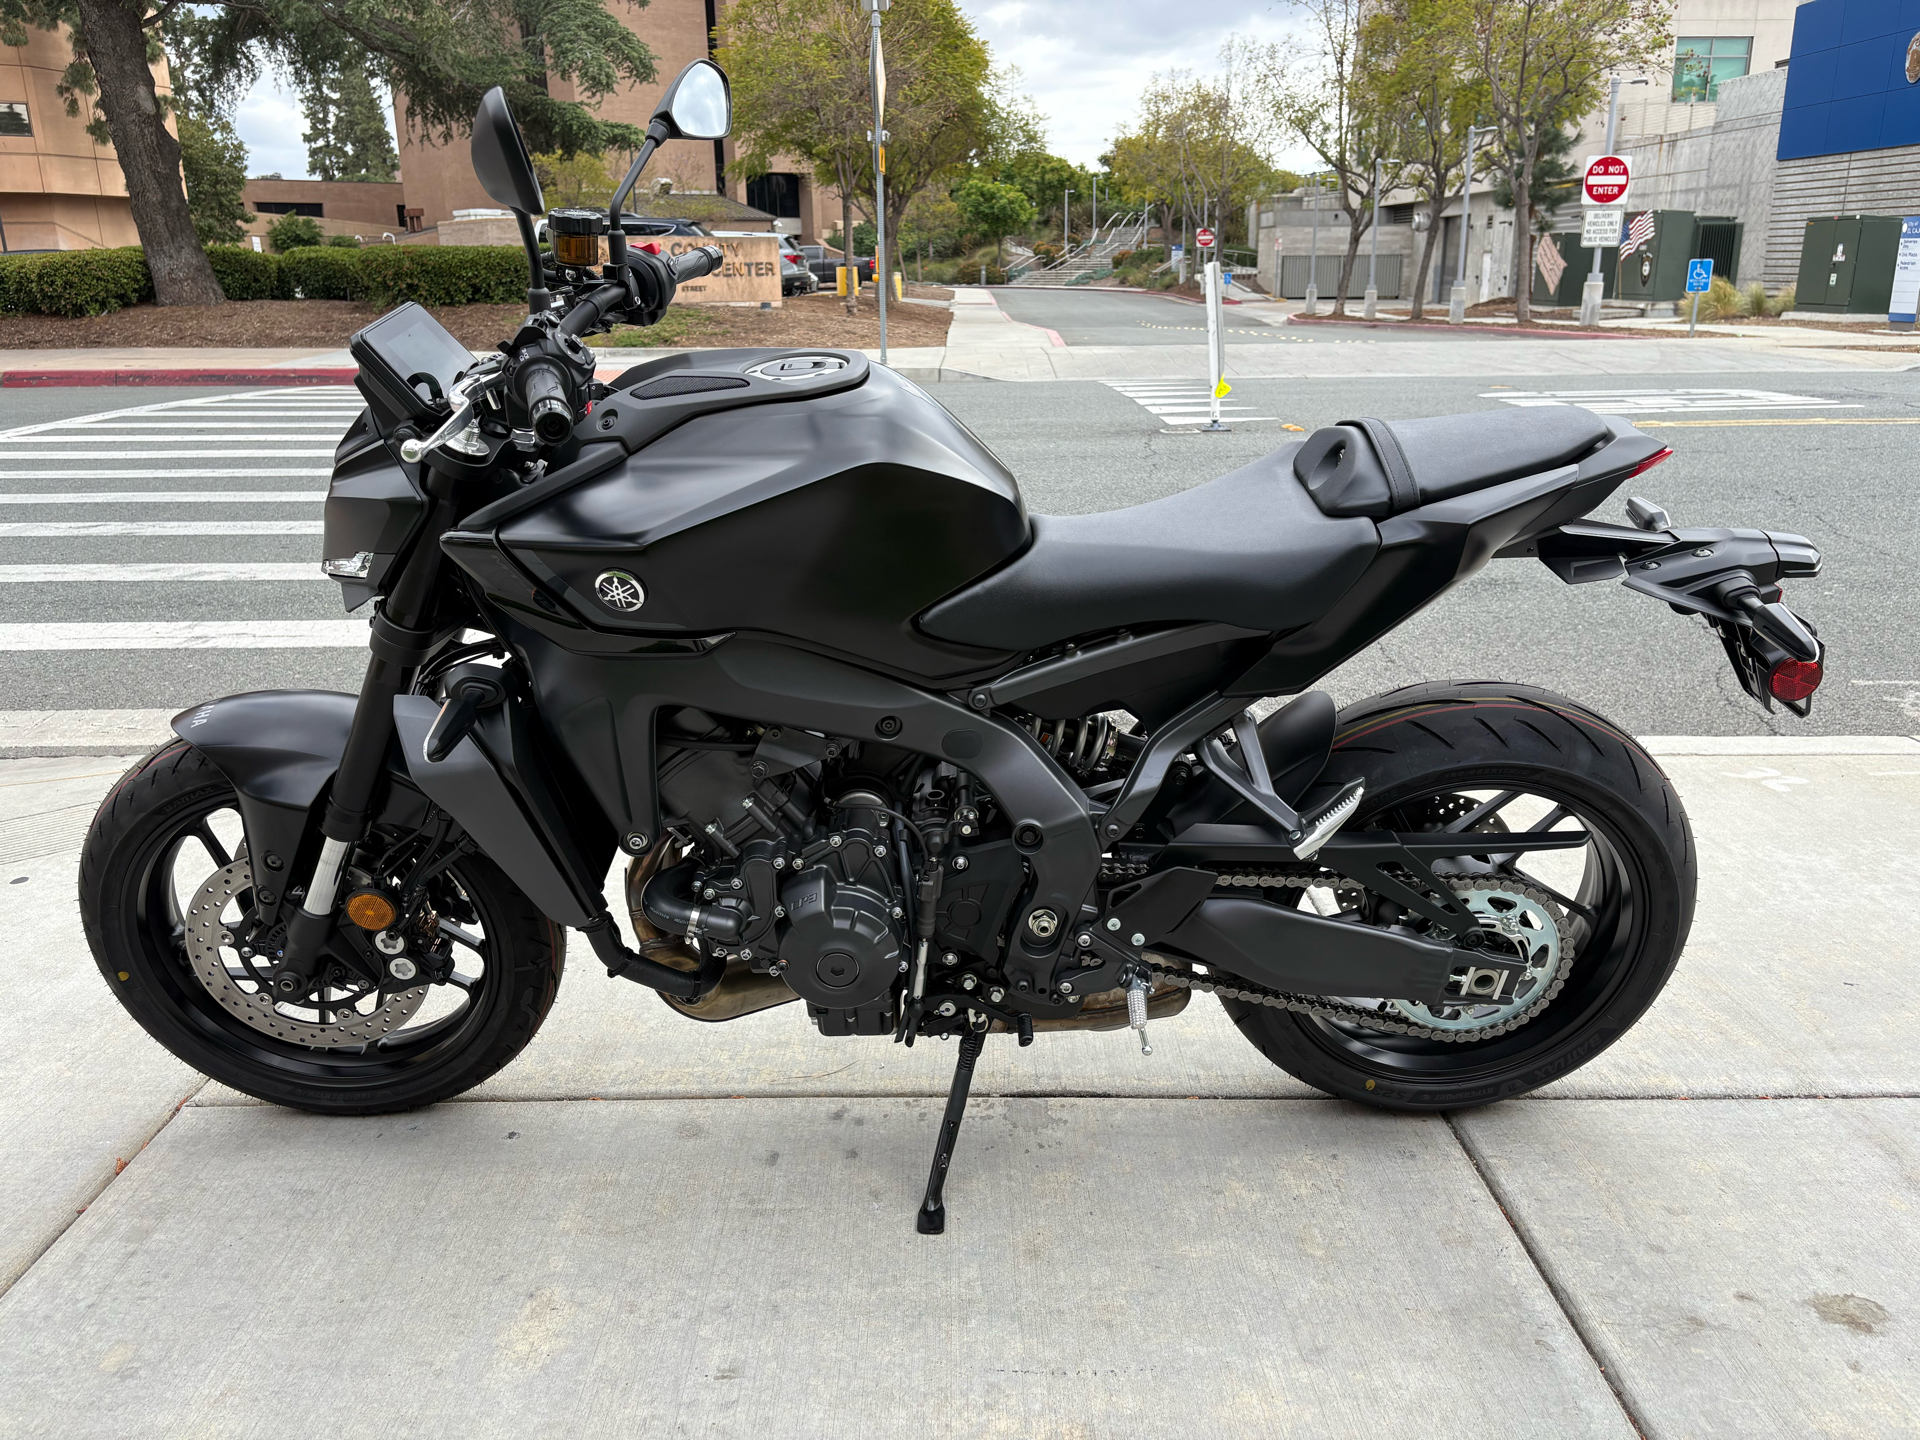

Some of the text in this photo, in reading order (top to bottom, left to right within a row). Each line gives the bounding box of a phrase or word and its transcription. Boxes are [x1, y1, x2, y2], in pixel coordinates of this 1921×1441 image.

[1592, 165, 1625, 174] DO NOT
[1592, 186, 1619, 195] ENTER
[670, 242, 741, 257] COTY
[162, 786, 215, 813] BATTLAX
[1534, 1033, 1603, 1080] BATTLAX
[1434, 1086, 1495, 1102] HYPERSPORT
